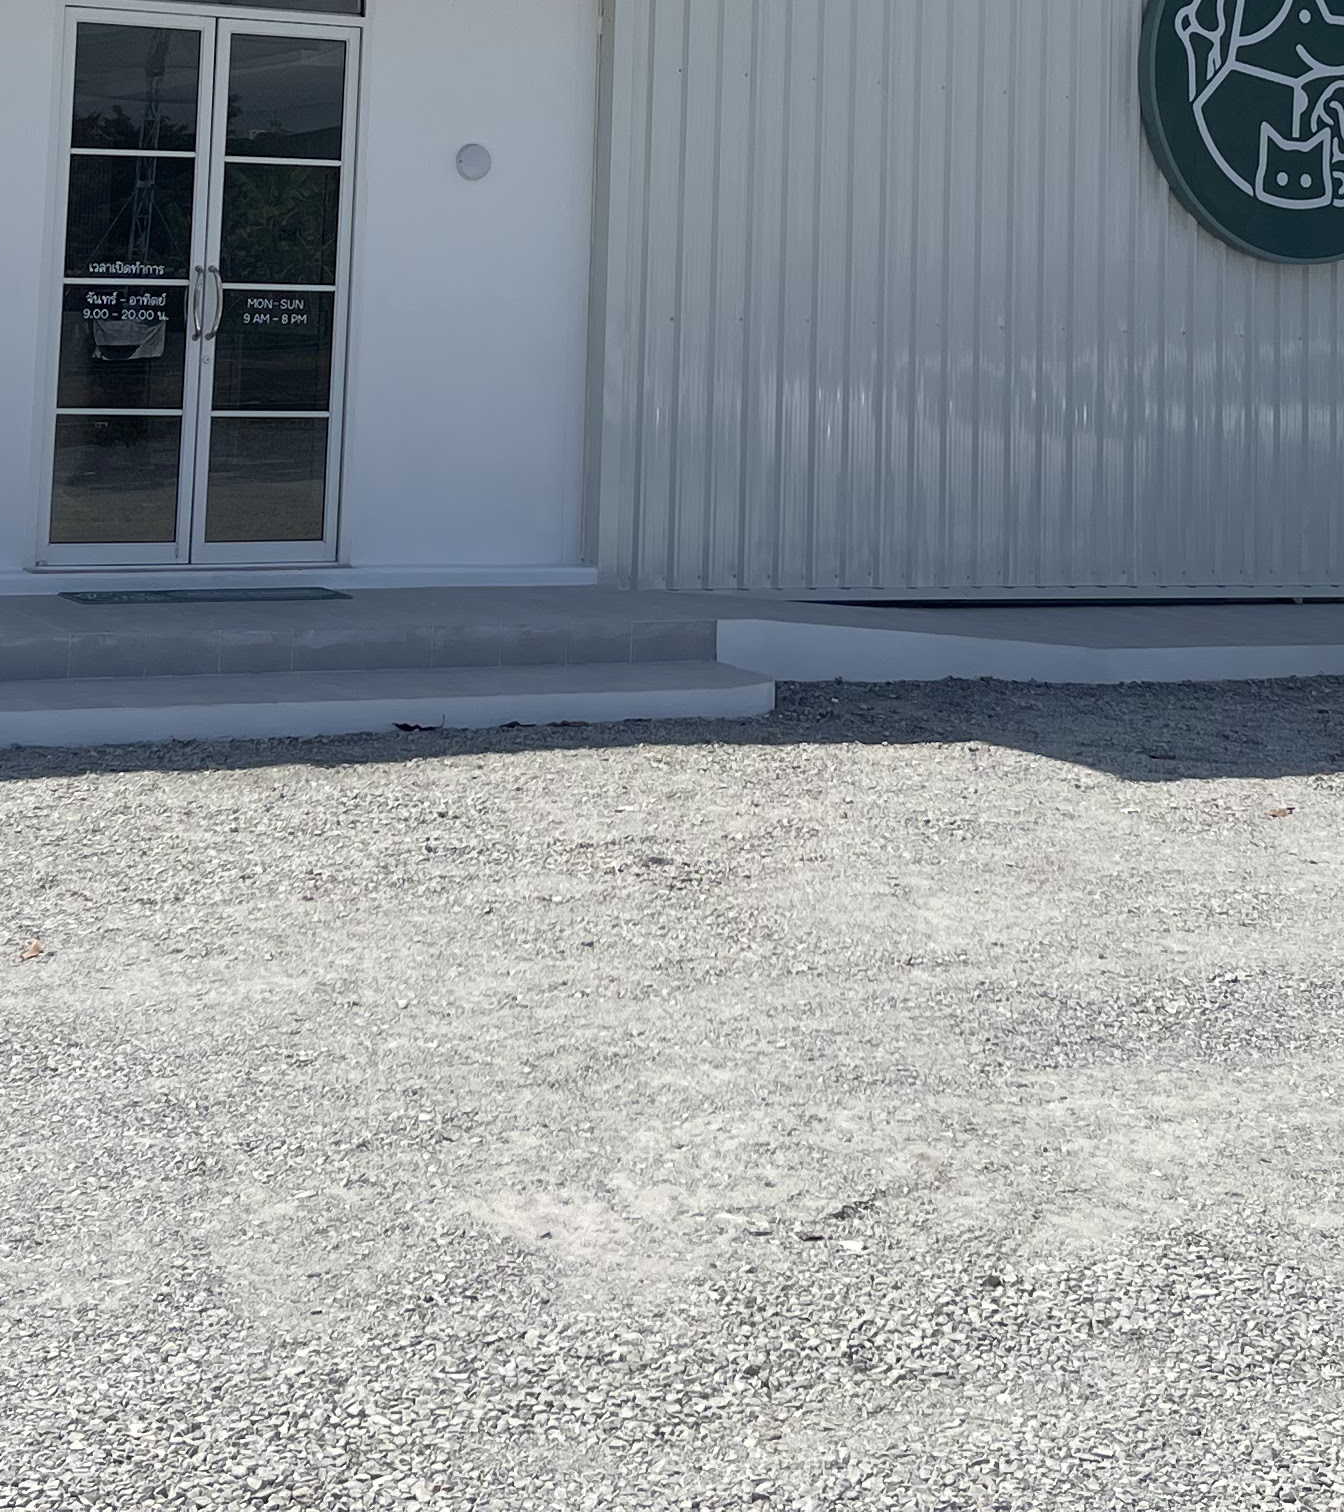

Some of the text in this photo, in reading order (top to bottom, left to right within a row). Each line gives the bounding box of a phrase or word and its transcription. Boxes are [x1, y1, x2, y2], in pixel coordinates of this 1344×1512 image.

[88, 260, 165, 275] เวลาเปิดทำการ
[85, 291, 118, 306] จันทร์
[129, 292, 167, 307] อาทิตย์
[82, 308, 109, 319] 9.00
[121, 309, 155, 321] 20.00
[243, 313, 251, 324] 9
[252, 313, 270, 324] AM
[281, 313, 289, 324] 8
[290, 313, 308, 325] PM
